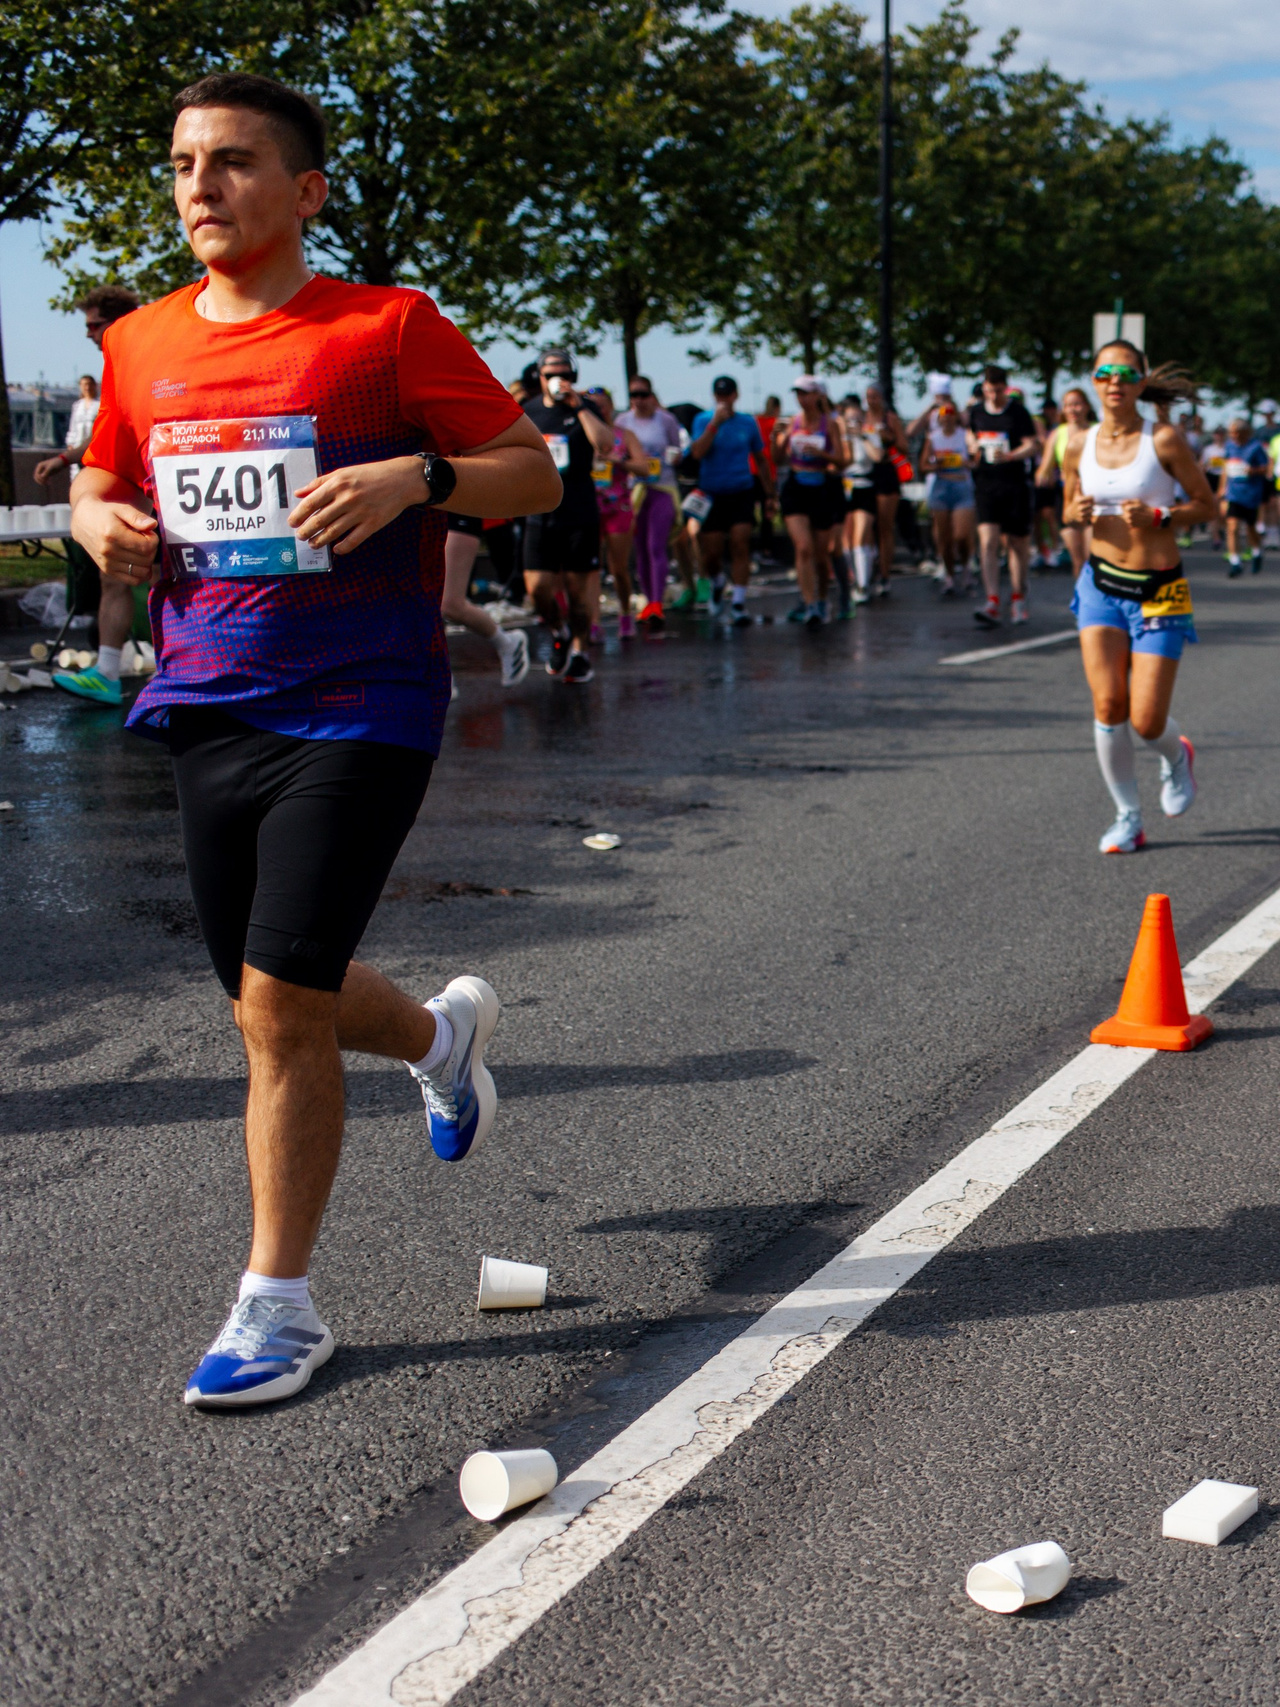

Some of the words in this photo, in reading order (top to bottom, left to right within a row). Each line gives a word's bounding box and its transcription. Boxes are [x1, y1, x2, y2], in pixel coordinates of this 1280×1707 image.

[173, 426, 198, 435] ПОЛУ
[243, 429, 265, 442] 21,1
[269, 427, 290, 440] КМ
[173, 434, 220, 445] МАРАФОН
[176, 463, 289, 514] 5401
[206, 516, 266, 532] ЭЛЬДАР
